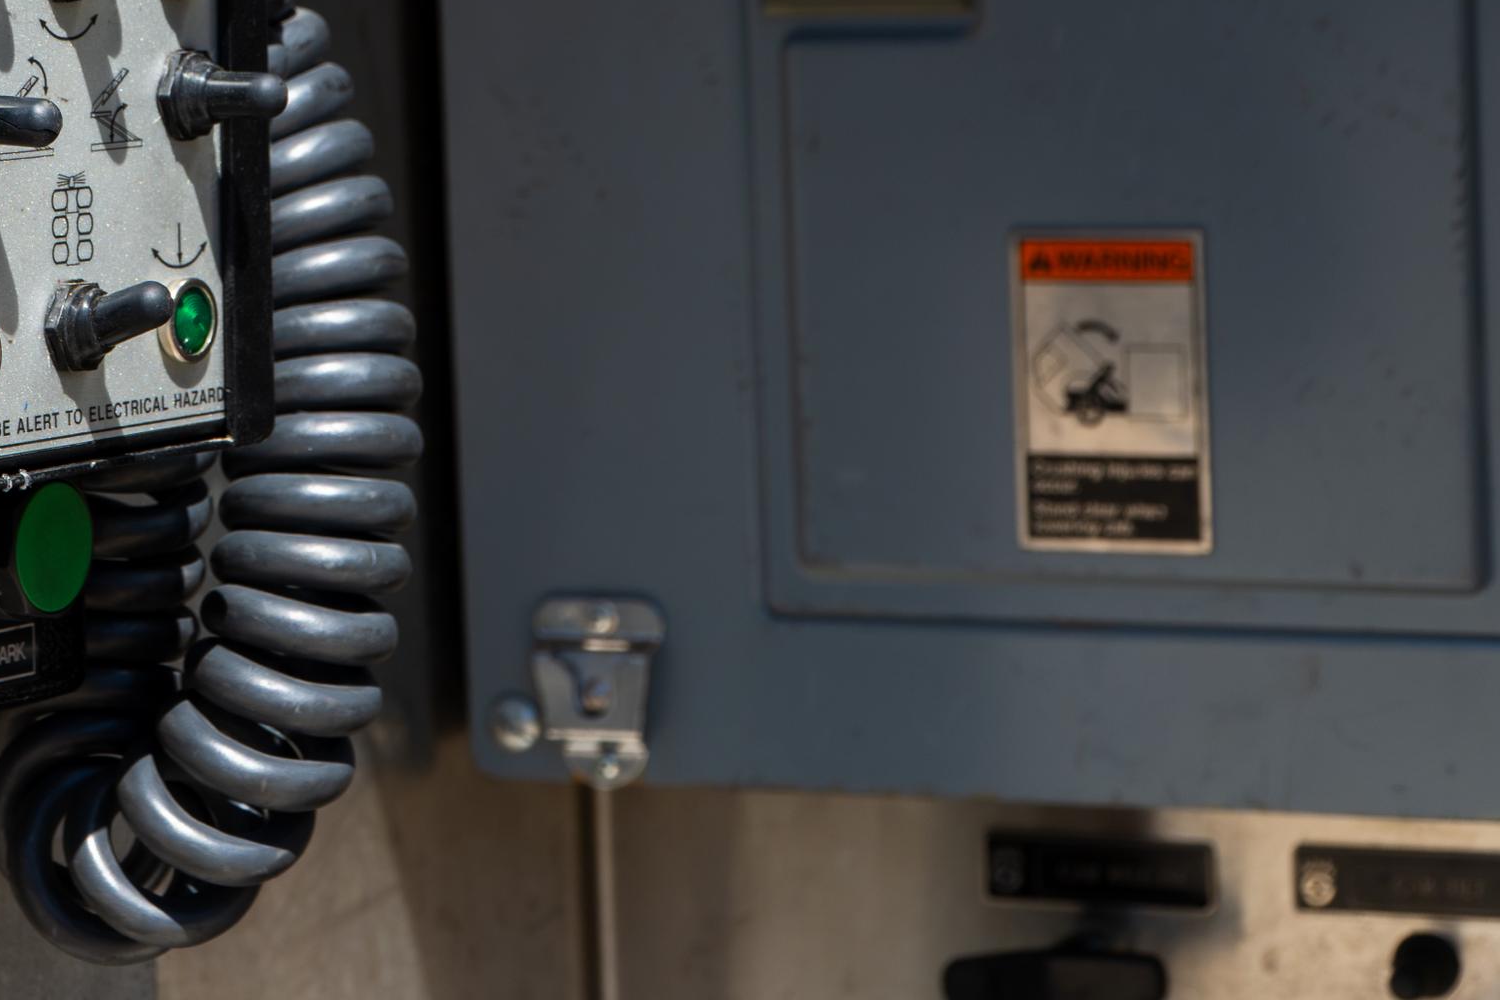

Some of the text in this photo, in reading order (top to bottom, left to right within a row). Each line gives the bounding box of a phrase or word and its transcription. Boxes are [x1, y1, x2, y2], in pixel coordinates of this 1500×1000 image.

[16, 412, 60, 434] ALERT
[65, 408, 84, 426] TO
[88, 394, 169, 424] ELECTRICAL
